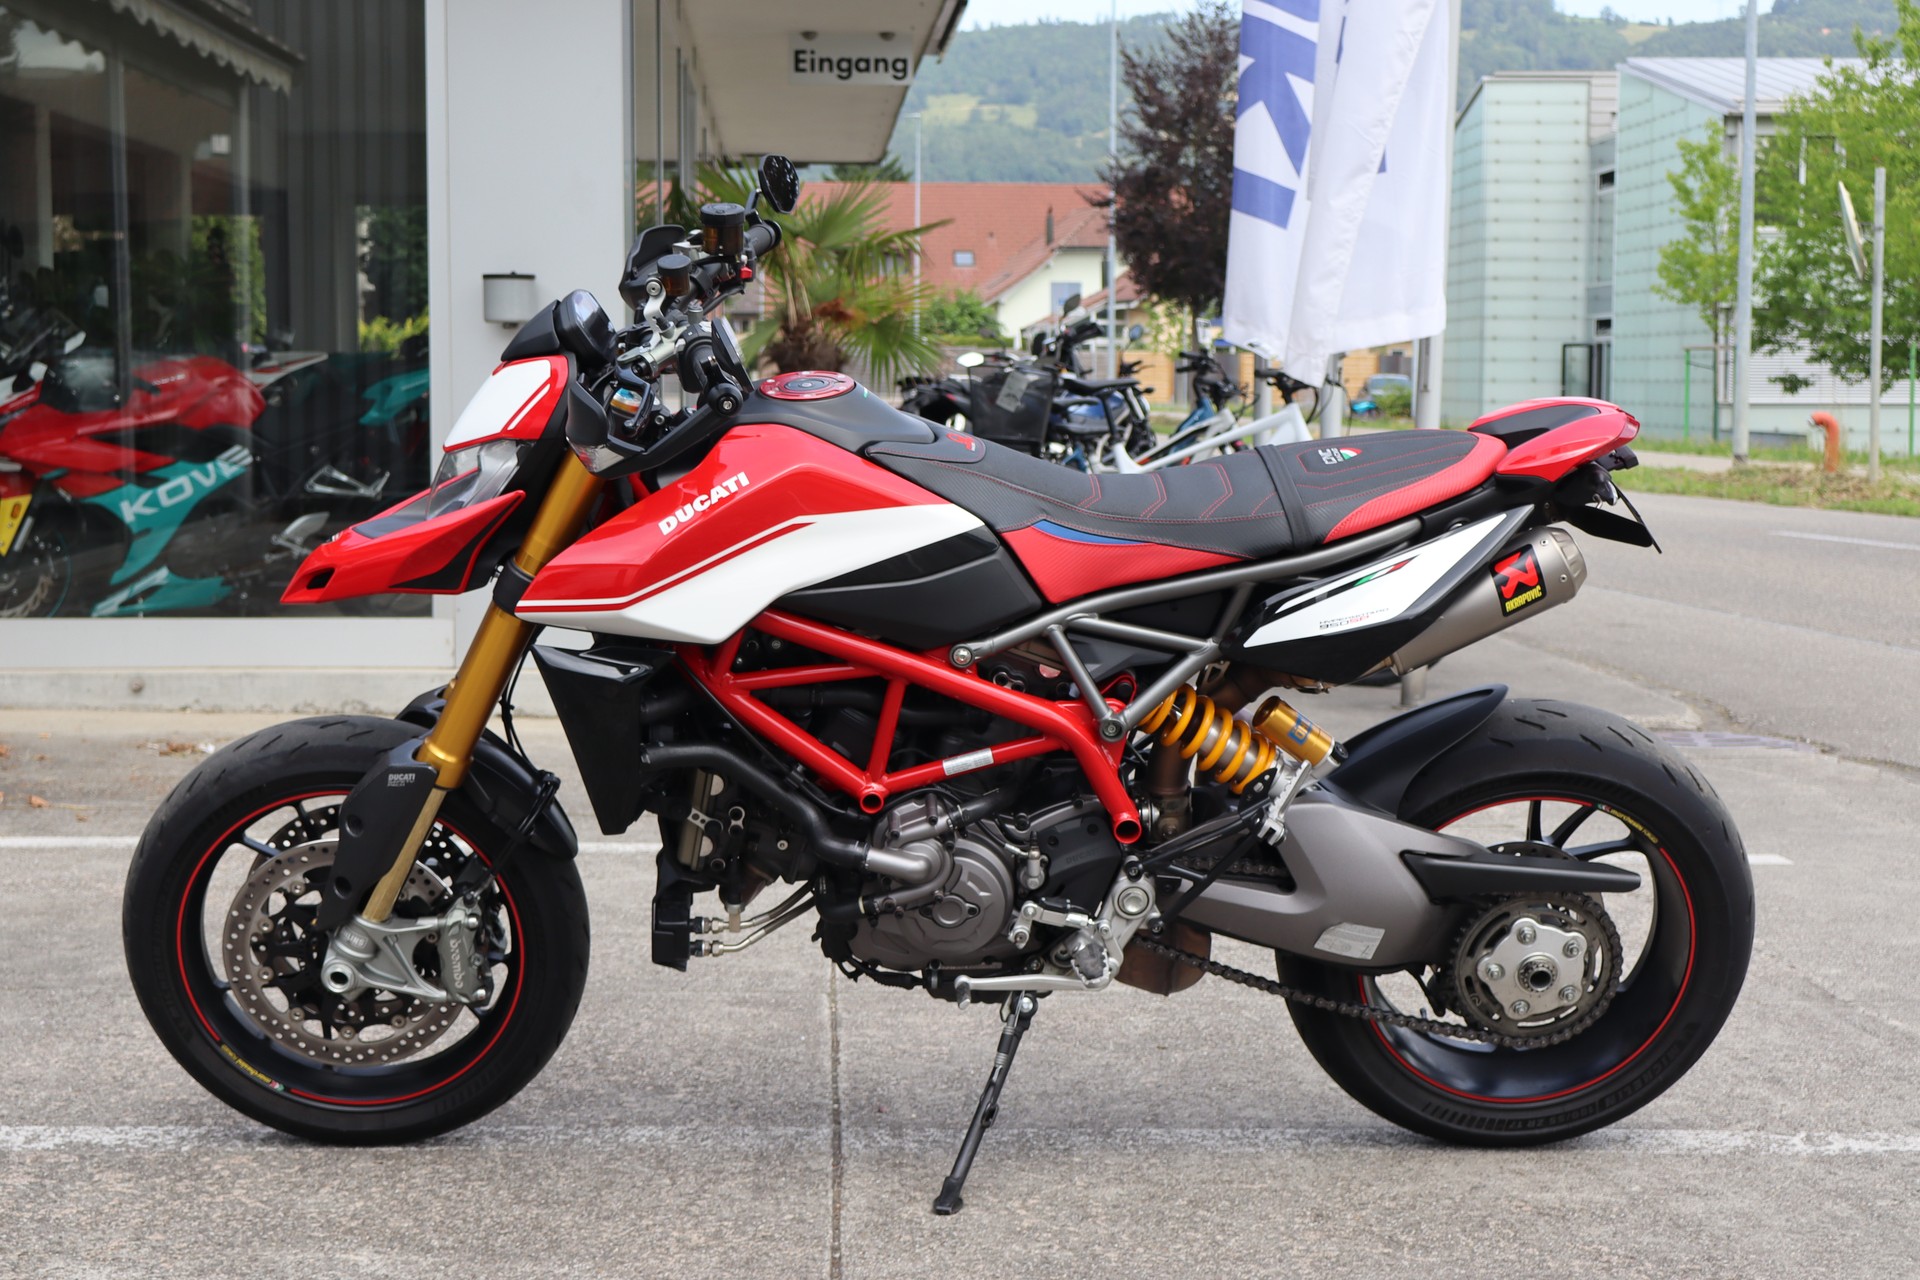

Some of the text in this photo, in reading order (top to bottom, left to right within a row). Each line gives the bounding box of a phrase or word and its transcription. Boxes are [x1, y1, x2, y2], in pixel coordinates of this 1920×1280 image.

[794, 50, 908, 80] Eingang
[119, 444, 253, 524] KOVE
[658, 471, 750, 536] DUCATI
[388, 773, 416, 781] DUCATI
[450, 938, 464, 988] brembo
